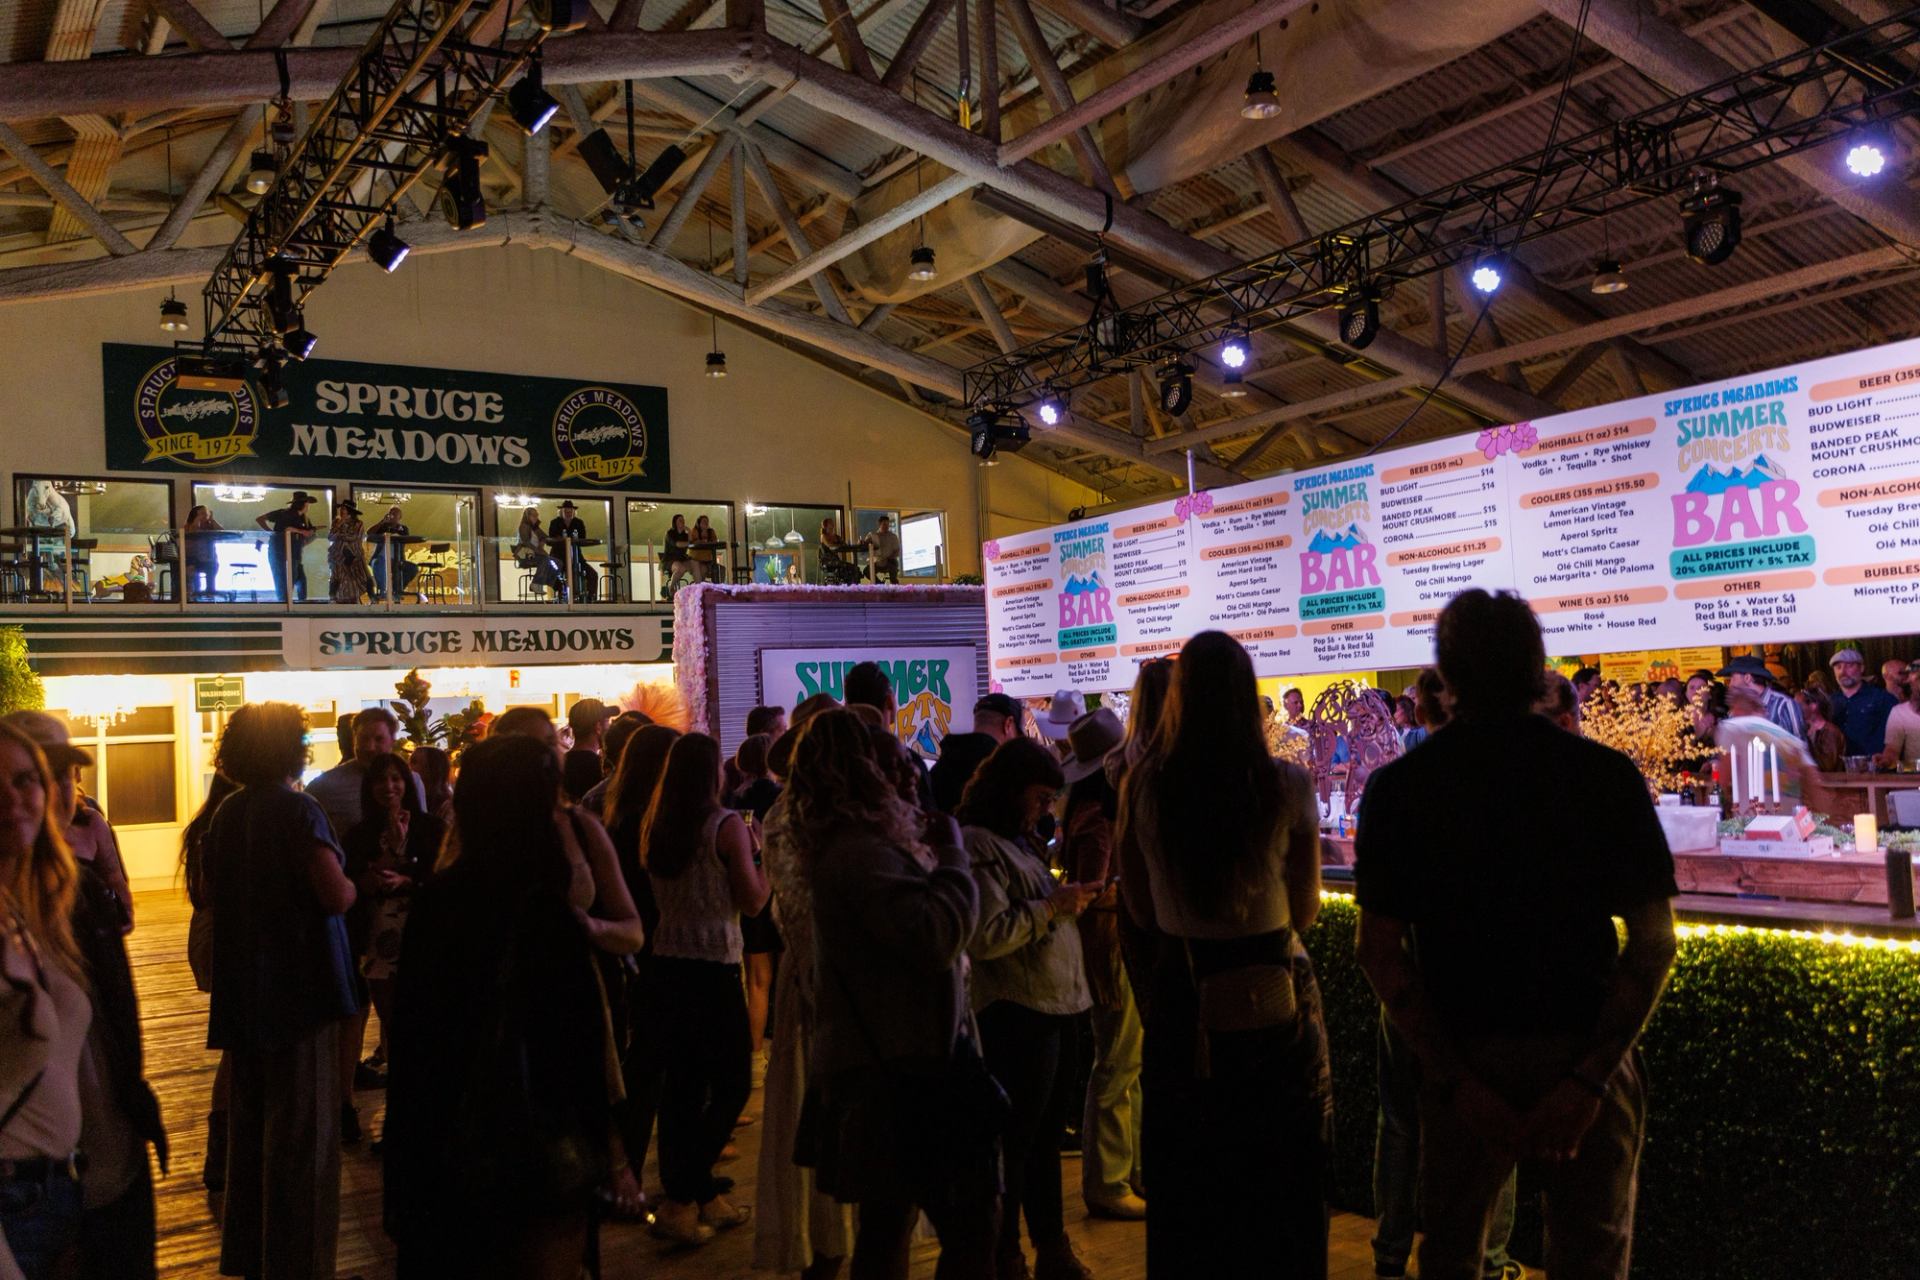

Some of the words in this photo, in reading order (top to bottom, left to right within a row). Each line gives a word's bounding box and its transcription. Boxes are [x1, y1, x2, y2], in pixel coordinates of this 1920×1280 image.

[142, 362, 176, 418] SPRUC
[1859, 374, 1891, 388] BEER
[316, 380, 504, 424] SPRUCE
[1664, 392, 1720, 417] SPRUCE
[1722, 376, 1798, 406] MEADOWS
[1808, 405, 1833, 417] BUD
[1836, 397, 1872, 412] LIGHT
[558, 394, 588, 442] SPRUCE
[594, 392, 643, 447] MEADOWS
[1677, 400, 1788, 448] SUMMER
[1809, 414, 1881, 434] BUDWEISER
[156, 434, 193, 454] SINCE
[206, 438, 241, 456] 1975
[289, 424, 531, 468] MEADOWS
[1539, 436, 1583, 450] HIGHBALL
[1585, 433, 1594, 442] (1
[1596, 430, 1610, 439] oz)
[1614, 426, 1628, 436] $14
[1810, 435, 1862, 450] BANDED
[1866, 428, 1898, 442] PEAK
[1522, 459, 1547, 469] Vodka
[1560, 452, 1579, 462] Rum
[1594, 448, 1610, 457] Rye
[1612, 440, 1650, 452] Whiskey
[1678, 426, 1791, 472] CONCERTS
[1811, 447, 1856, 462] MOUNT
[570, 457, 598, 472] SINCE
[607, 460, 634, 474] 1975
[1410, 466, 1428, 476] BEER
[1431, 462, 1447, 472] (355
[1449, 458, 1463, 468] mL)
[1539, 468, 1553, 476] Gin
[1566, 460, 1596, 472] Tequila
[1611, 453, 1632, 463] Shot
[1812, 463, 1866, 478] CORONA
[1380, 487, 1394, 496] BUD
[1397, 482, 1418, 492] LIGHT
[1481, 468, 1494, 476] $14
[1302, 482, 1368, 516] SUMMER
[1381, 496, 1423, 508] BUDWEISER
[1482, 482, 1494, 490] $14
[1531, 491, 1571, 504] COOLERS
[1574, 488, 1592, 498] (355
[1595, 484, 1612, 494] mL)
[1615, 479, 1645, 490] $15.50
[1382, 510, 1411, 522] BANDED
[1414, 507, 1432, 516] PEAK
[1382, 520, 1408, 530] MOUNT
[1410, 512, 1456, 526] CRUSHMORE
[1483, 505, 1496, 514] $15
[1544, 517, 1572, 528] Lemon
[1574, 513, 1594, 524] Hard
[1597, 510, 1616, 520] Iced
[1618, 508, 1634, 517] Tea
[1549, 506, 1588, 518] American
[1591, 500, 1626, 512] Vintage
[1670, 479, 1808, 548] BAR
[1846, 506, 1894, 518] Tuesday
[1898, 502, 1920, 512] Bre
[1304, 501, 1370, 536] CONCERTS
[1868, 522, 1888, 533] Olé
[1893, 518, 1919, 530] Chili
[1384, 533, 1414, 544] CORONA
[1484, 519, 1497, 528] $15
[1560, 530, 1588, 542] Aperol
[1591, 526, 1618, 537] Spritz
[1060, 537, 1105, 564] SUMMER
[1124, 538, 1138, 547] LIGHT
[1399, 546, 1460, 561] NON-ALCOHOLIC
[1463, 542, 1486, 552] $11.25
[1542, 548, 1568, 558] Mott's
[1570, 544, 1606, 554] Clamato
[1609, 540, 1640, 550] Caesar
[1876, 539, 1896, 550] Olé
[1114, 550, 1142, 560] BUDWEISER
[1682, 552, 1702, 564] ALL
[1705, 547, 1744, 560] PRICES
[1748, 542, 1800, 556] INCLUDE
[1114, 562, 1134, 570] BANDED
[1114, 569, 1132, 577] MOUNT
[1133, 564, 1163, 574] CRUSHMORE
[1222, 559, 1248, 569] American
[1250, 556, 1272, 566] Vintage
[1299, 543, 1382, 595] BAR
[1402, 566, 1430, 575] Tuesday
[1432, 562, 1460, 572] Brewing
[1463, 559, 1484, 568] Lager
[1557, 561, 1571, 572] Olé
[1574, 558, 1593, 569] Chili
[1596, 556, 1626, 568] Mango
[1676, 566, 1696, 576] 20%
[1699, 559, 1754, 573] GRATUITY
[1768, 556, 1783, 566] 5%
[1786, 552, 1810, 563] TAX
[1864, 564, 1920, 578] BUBBLES
[1230, 578, 1248, 588] Aperol
[1250, 576, 1267, 584] Spritz
[1429, 576, 1444, 586] Chili
[1447, 574, 1472, 584] Mango
[1534, 574, 1548, 584] Olé
[1550, 570, 1590, 582] Margarita
[1602, 566, 1618, 576] Olé
[1620, 564, 1654, 574] Paloma
[1115, 580, 1136, 588] CORONA
[1724, 581, 1760, 592] OTHER
[1854, 584, 1908, 596] Mionetto
[1236, 590, 1260, 598] Clamato
[1320, 596, 1344, 606] PRICES
[1346, 592, 1376, 602] INCLUDE
[1559, 598, 1582, 608] WINE
[1586, 596, 1594, 606] (5
[1596, 595, 1610, 605] oz)
[1614, 594, 1630, 603] $16
[1058, 587, 1114, 628] BAR
[1694, 602, 1714, 612] Pop
[1717, 600, 1730, 610] $6
[1746, 596, 1778, 606] Water
[1696, 612, 1715, 621] Red
[1718, 610, 1738, 620] Bull
[1740, 608, 1748, 618] &
[1752, 606, 1772, 616] Red
[1776, 605, 1796, 614] Bull
[1566, 622, 1593, 632] White
[1607, 620, 1635, 629] House
[1638, 617, 1656, 626] Red
[1584, 612, 1605, 620] Rosé
[1704, 622, 1732, 632] Sugar
[1736, 618, 1758, 629] Free
[1762, 616, 1790, 627] $7.50
[1331, 622, 1354, 630] OTHER
[319, 630, 462, 655] SPRUCE
[472, 628, 634, 651] MEADOWS
[1648, 664, 1680, 681] BAR
[796, 660, 951, 704] SUMER
